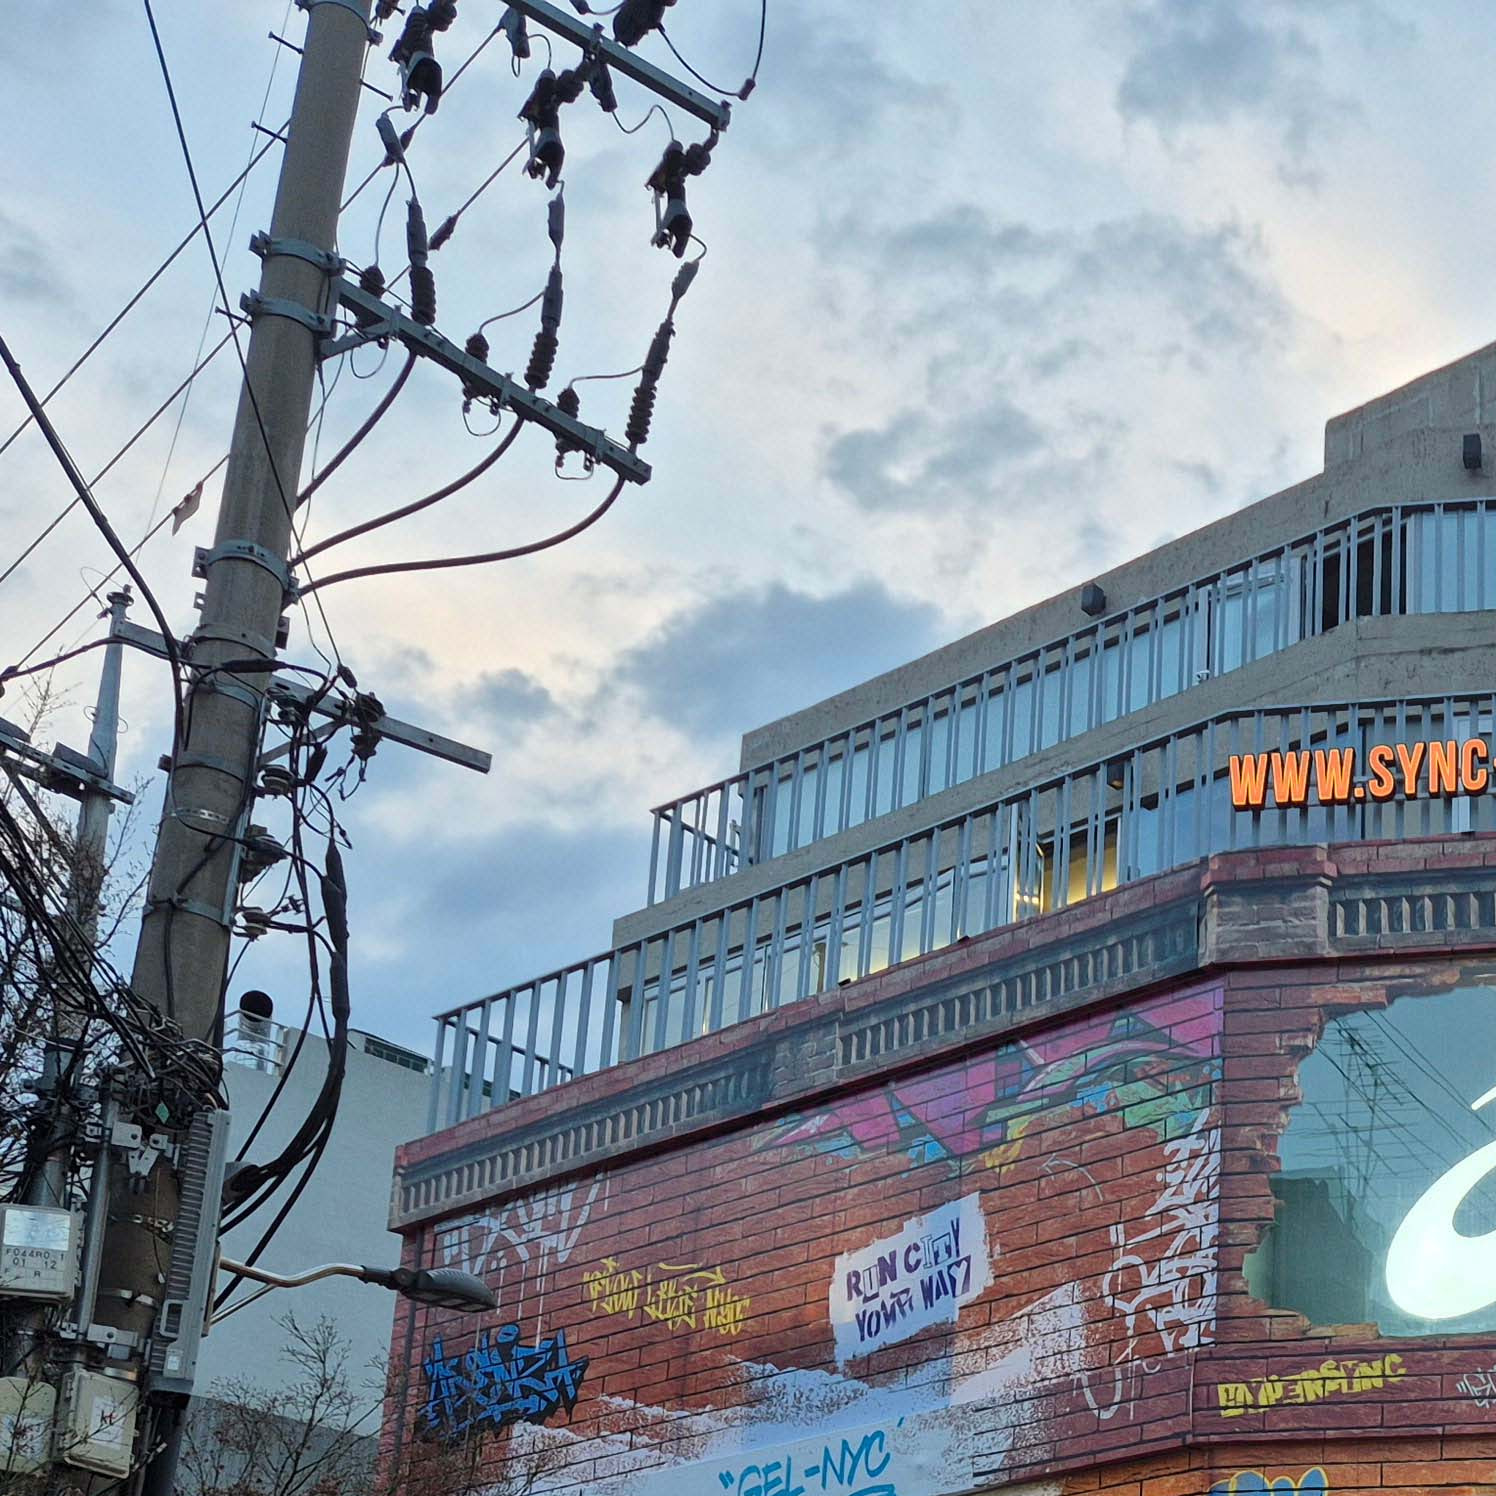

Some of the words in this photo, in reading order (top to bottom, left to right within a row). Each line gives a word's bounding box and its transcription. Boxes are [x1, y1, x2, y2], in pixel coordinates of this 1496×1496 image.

[846, 1249, 898, 1304] RUN
[903, 1217, 960, 1274] CITY
[920, 1254, 972, 1311] WAY
